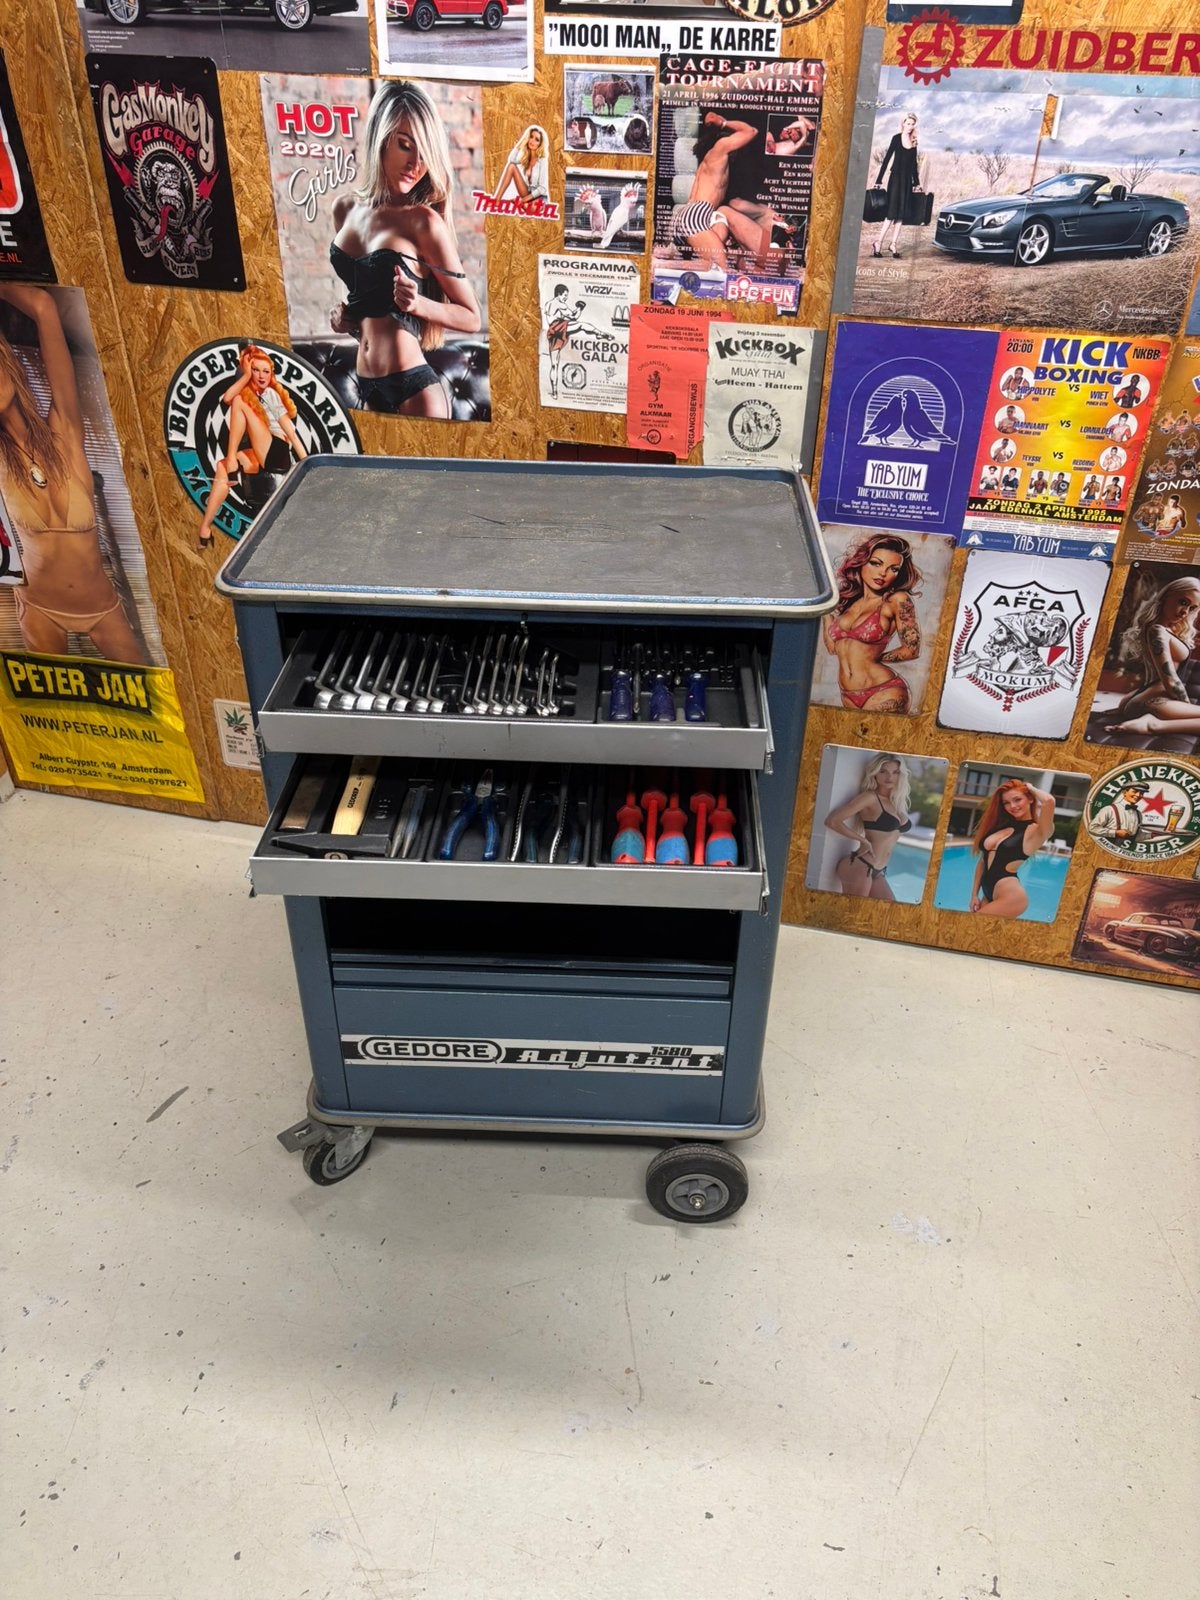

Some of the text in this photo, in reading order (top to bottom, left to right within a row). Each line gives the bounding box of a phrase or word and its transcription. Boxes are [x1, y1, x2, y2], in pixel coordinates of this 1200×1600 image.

[679, 26, 703, 50] DE
[711, 27, 777, 52] KARRE
[667, 57, 820, 77] CAGE-FIGHT
[667, 73, 819, 93] TOURNAMENT
[674, 91, 699, 99] APRIL
[721, 94, 784, 104] ZUIDOOST-HAL
[788, 96, 820, 105] EMMEN
[275, 102, 358, 137] HOT
[130, 128, 196, 160] Garage
[280, 141, 335, 157] 2020
[288, 146, 357, 222] Girls
[544, 259, 637, 273] PROGRAMMA
[855, 266, 876, 276] Icons
[878, 267, 886, 277] of
[644, 306, 675, 315] ZONDAG
[571, 339, 628, 354] KICKBOX
[715, 337, 806, 366] KICKBOX
[1006, 342, 1033, 353] 20:00
[1041, 338, 1132, 368] KICK
[1132, 348, 1161, 360] NKBB
[581, 351, 617, 363] GALA
[731, 367, 785, 379] MUAY THAI
[1033, 366, 1123, 385] BOXING
[169, 349, 240, 436] BIGGER
[765, 382, 803, 390] Hattem
[1069, 384, 1080, 392] VS
[270, 353, 350, 448] SPARK
[1060, 420, 1071, 428] VS
[870, 463, 922, 487] YAB YUM
[905, 492, 929, 501] CHOICE
[969, 503, 997, 511] JAAP
[1000, 506, 1050, 517] EDENHAL
[1053, 512, 1122, 523] AMSTERDAM
[986, 499, 1030, 510] ZONDAG
[1044, 505, 1076, 514] APRIL
[1081, 509, 1107, 517] 1995
[1013, 535, 1035, 550] YAB
[1037, 538, 1061, 555] YUM
[993, 595, 1065, 613] AFCA
[7, 659, 148, 708] PETER JAN
[980, 670, 1048, 687] MOKUM
[21, 713, 164, 744] WWW.PETERJAN.NL
[39, 752, 64, 763] Albert
[121, 763, 173, 775] Amsterdam
[1119, 847, 1145, 858] FRIENDS
[1135, 837, 1184, 853] BIER
[373, 1042, 490, 1058] GEDORE
[651, 1046, 693, 1057] 1580
[518, 1050, 713, 1069] Adjutant
